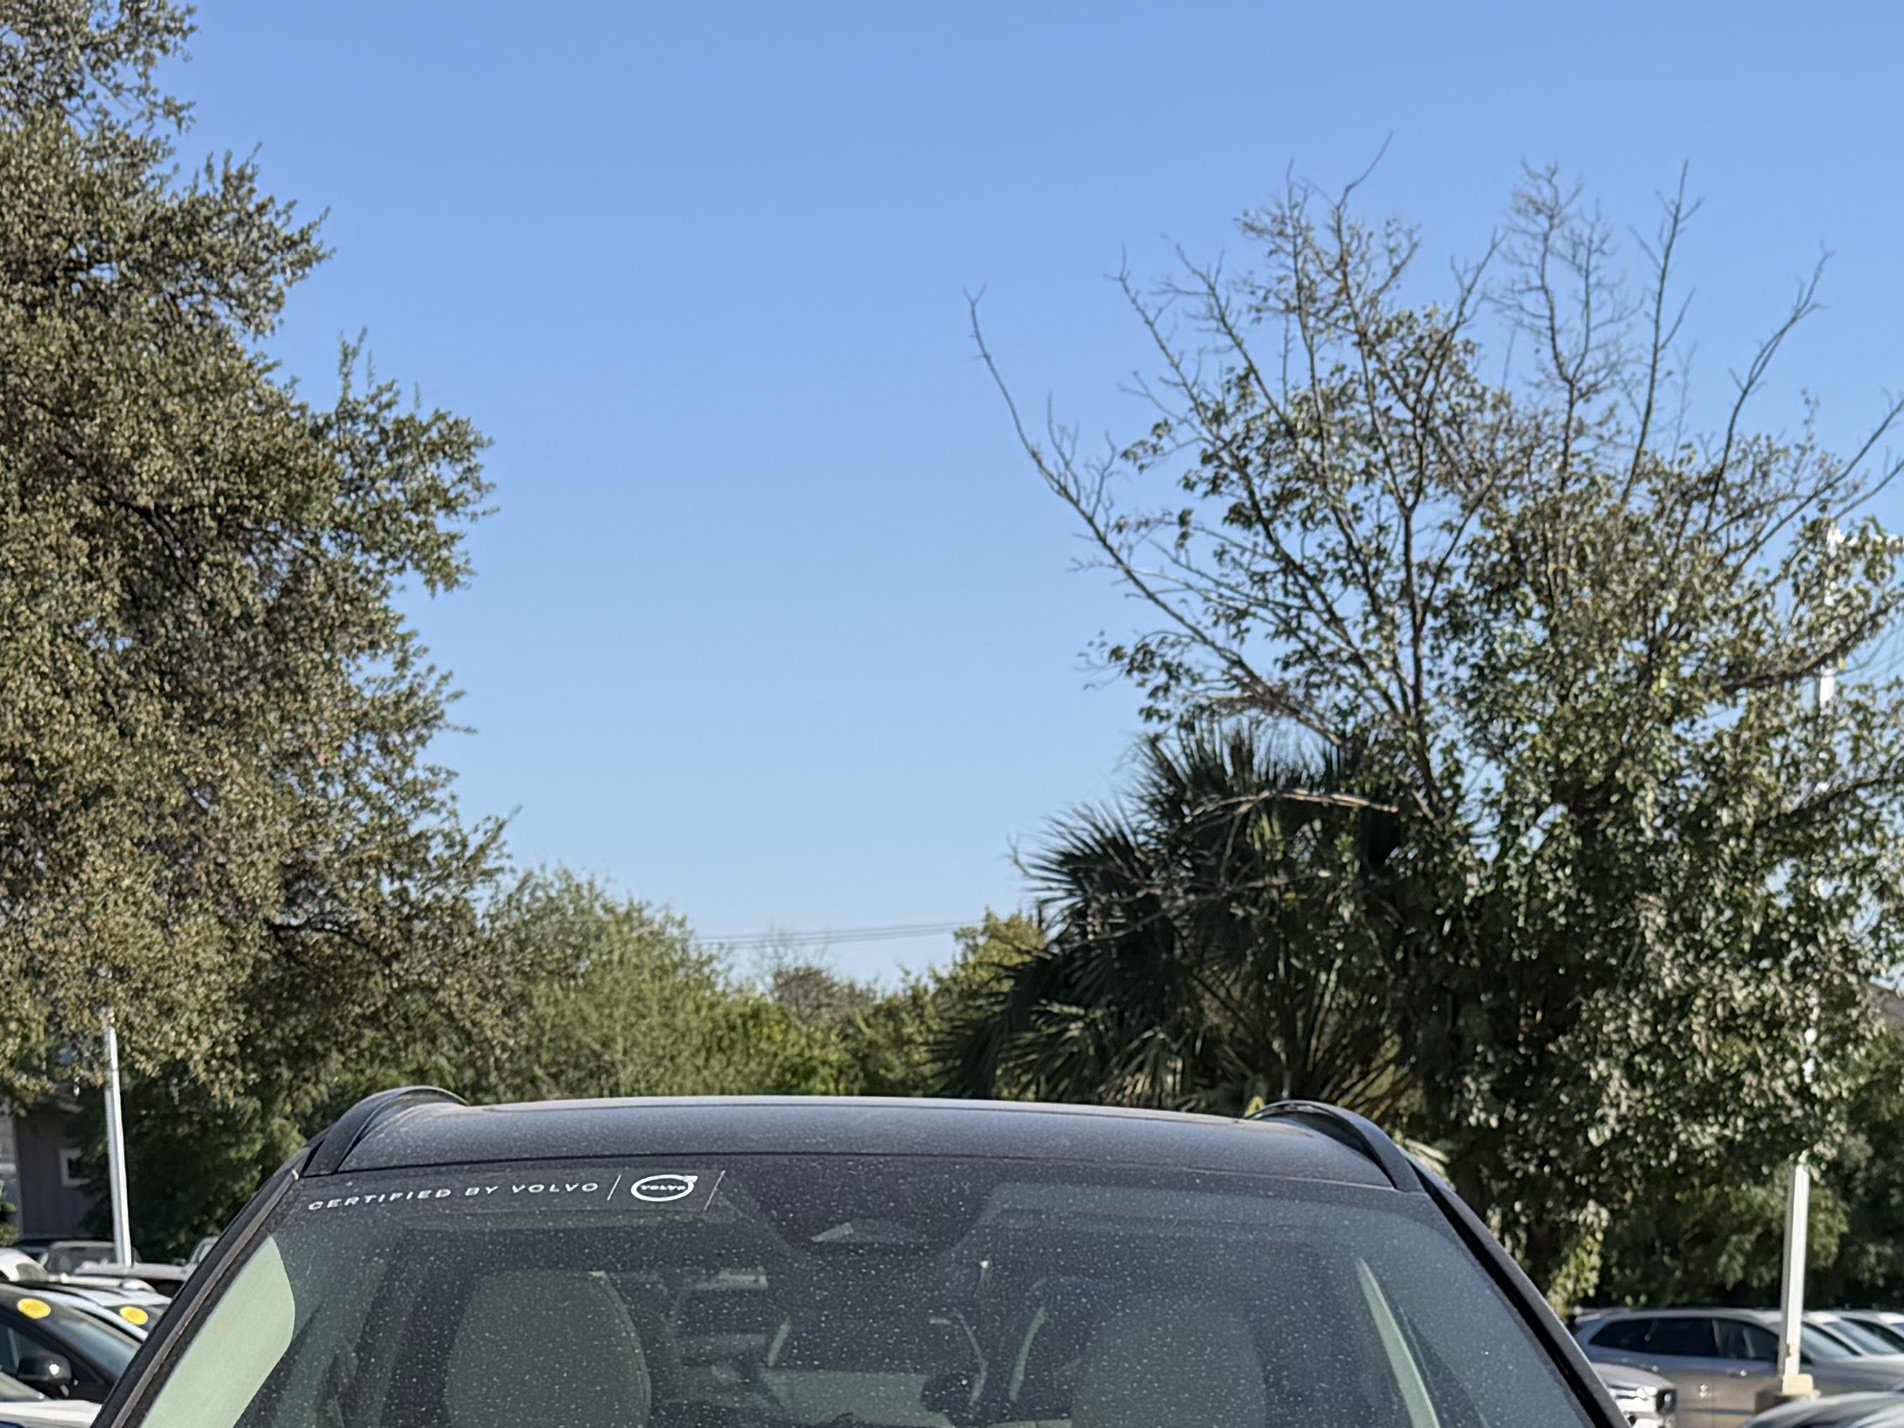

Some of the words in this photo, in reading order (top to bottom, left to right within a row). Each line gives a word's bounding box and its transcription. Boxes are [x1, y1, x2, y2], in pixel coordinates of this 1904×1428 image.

[308, 1188, 452, 1211] CERTIFIED
[464, 1185, 499, 1196] BY
[511, 1182, 599, 1194] VOLVO
